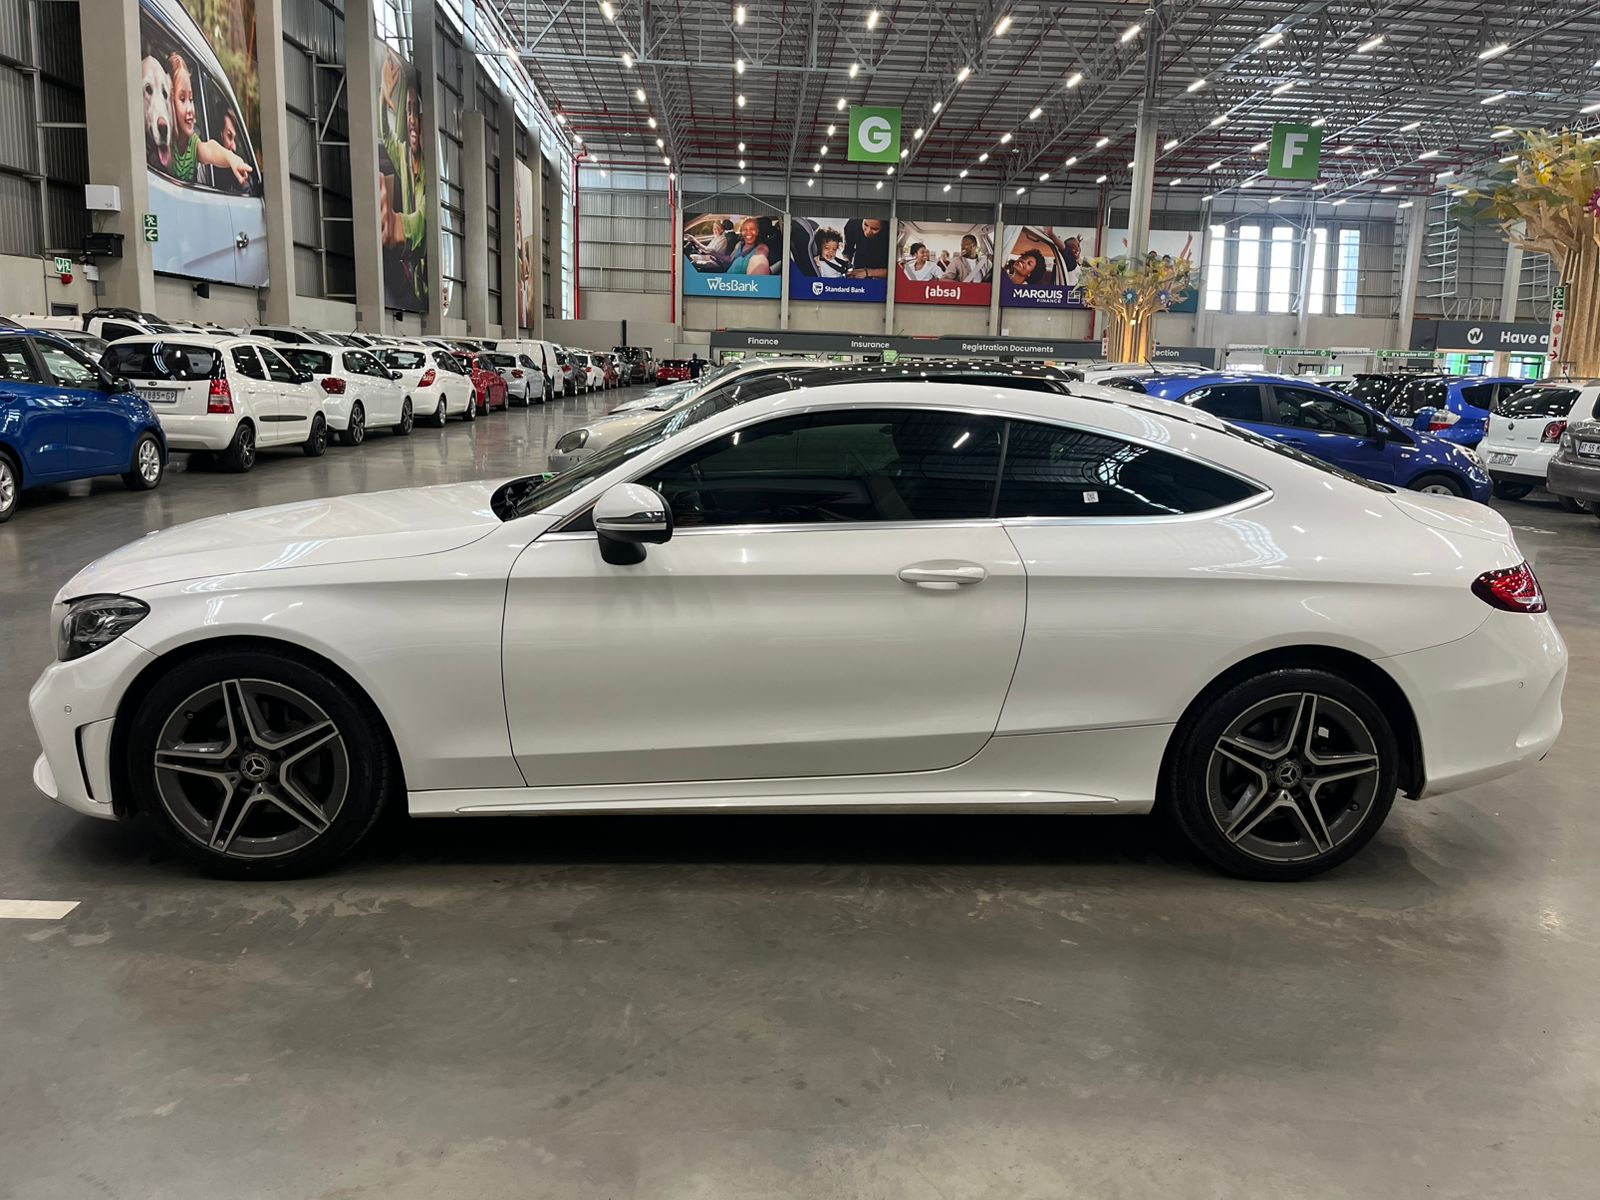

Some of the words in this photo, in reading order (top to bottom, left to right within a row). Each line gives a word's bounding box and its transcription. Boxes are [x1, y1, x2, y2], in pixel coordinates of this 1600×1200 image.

[858, 116, 892, 153] G
[1282, 133, 1309, 168] F
[707, 277, 758, 292] WesBank
[824, 285, 850, 293] Standard
[851, 286, 865, 294] Bank
[1013, 288, 1063, 299] MARQUIS
[747, 337, 779, 345] Finance
[1500, 331, 1537, 344] Have
[851, 340, 890, 348] Insurance
[961, 343, 1008, 352] Registration
[1009, 344, 1054, 353] Documents
[1155, 349, 1180, 357] ection
